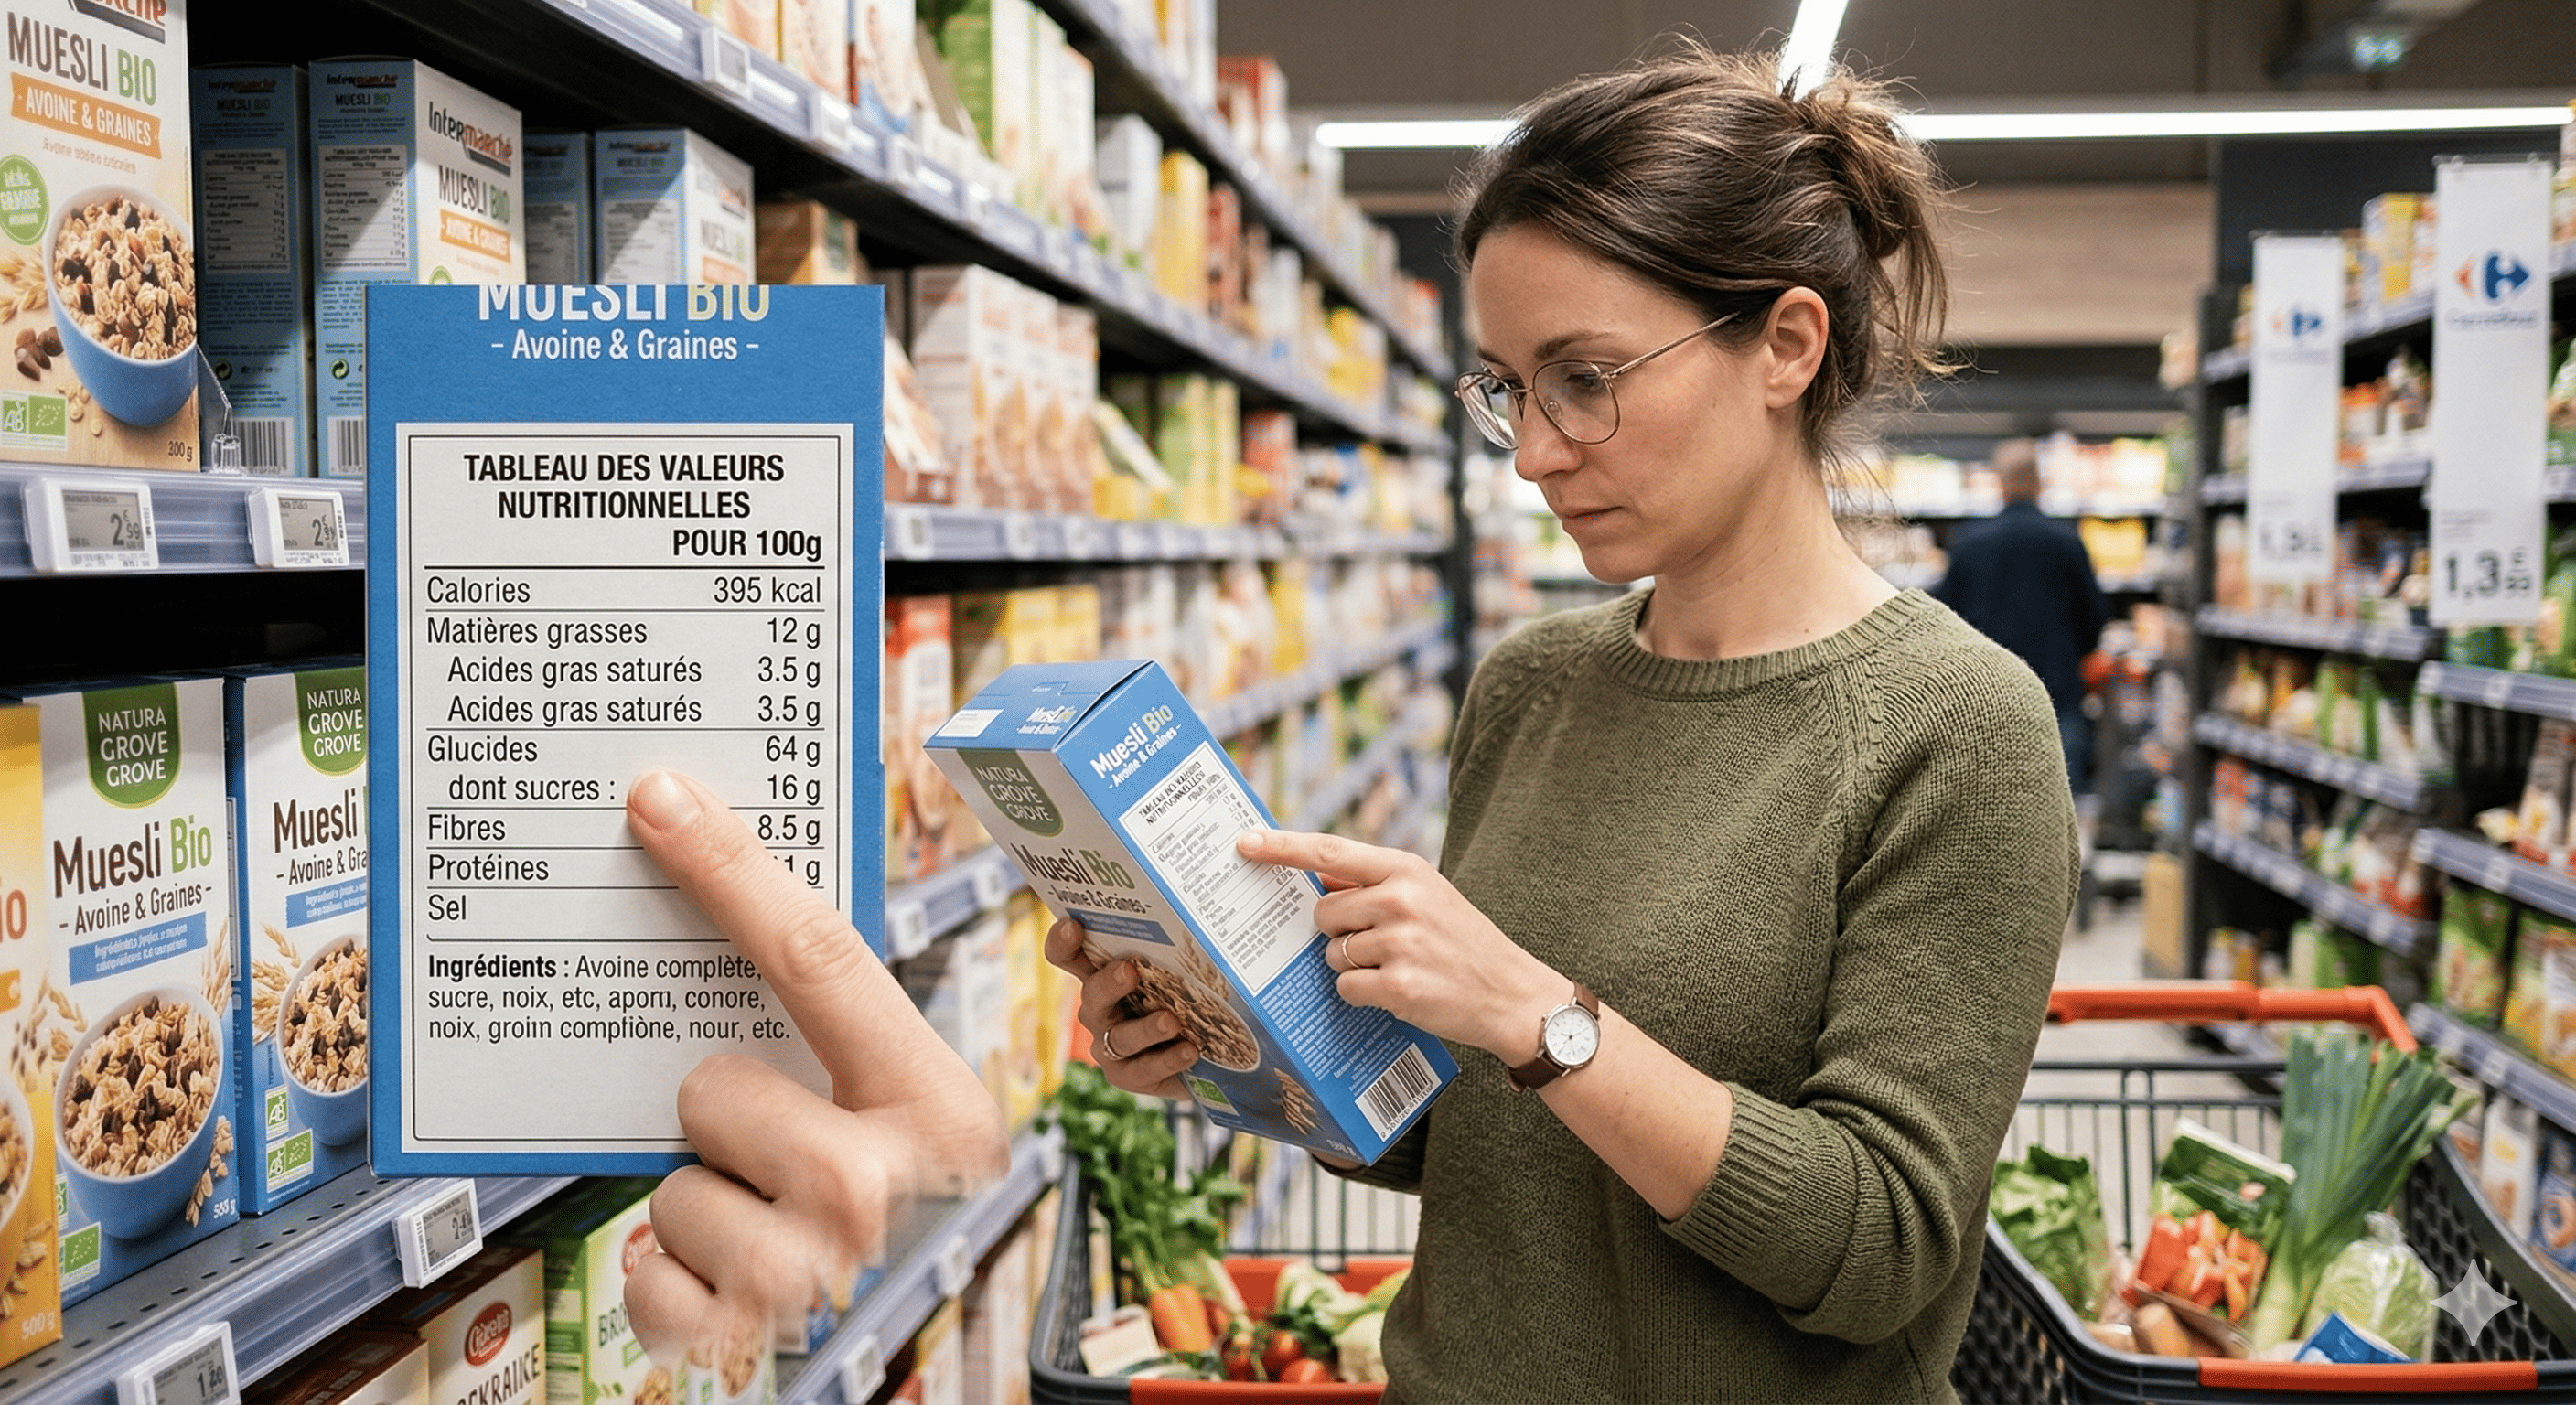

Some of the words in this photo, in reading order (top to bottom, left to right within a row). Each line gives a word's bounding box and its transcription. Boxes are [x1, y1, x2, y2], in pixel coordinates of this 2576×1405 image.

[7, 11, 109, 92] MUESLI
[117, 48, 157, 107] BIO
[26, 85, 80, 127] AVOINE
[81, 101, 93, 130] &
[96, 106, 152, 147] GRAINES
[437, 164, 488, 217] MUESLI
[478, 284, 667, 321] MUESLI
[511, 327, 602, 359] Avoine
[609, 327, 629, 359] &
[637, 327, 738, 359] Graines
[186, 445, 193, 463] g
[462, 453, 588, 483] TABLEAU
[596, 453, 652, 483] DES
[659, 453, 785, 483] VALEURS
[498, 489, 752, 520] NUTRITIONNELLES
[672, 528, 747, 557] POUR
[757, 529, 822, 563] 100g
[426, 574, 531, 605] Calories
[713, 575, 763, 605] 395
[771, 575, 821, 605] kcal
[426, 616, 539, 645] Matières
[546, 622, 649, 650] grasses
[767, 616, 799, 644] 12
[805, 622, 821, 650] g
[446, 654, 534, 684] Acides
[542, 660, 599, 690] gras
[606, 654, 703, 684] saturés
[757, 654, 799, 684] 3.5
[805, 660, 821, 690] g
[306, 687, 363, 711] NATURA
[446, 694, 534, 724] Acides
[542, 700, 599, 729] gras
[606, 693, 703, 724] saturés
[757, 693, 799, 723] 3.5
[805, 700, 821, 728] g
[97, 706, 167, 734] NATURA
[308, 708, 364, 735] GROVE
[100, 730, 170, 762] GROVE
[313, 733, 362, 758] GROVE
[426, 734, 539, 763] Glucides
[765, 734, 799, 763] 64
[805, 740, 821, 768] g
[1089, 721, 1150, 780] Muesli
[1141, 704, 1174, 735] Bio
[105, 758, 167, 788] GROVE
[447, 773, 508, 801] dont
[514, 778, 601, 802] sucres
[767, 773, 799, 801] 16
[805, 778, 821, 807] g
[274, 788, 358, 853] Muesli
[427, 812, 507, 842] Fibres
[757, 813, 798, 842] 8.5
[805, 819, 821, 847] g
[53, 820, 162, 900] Muesli
[170, 813, 213, 874] Bio
[288, 853, 333, 885] Avoine
[336, 848, 347, 874] &
[428, 853, 550, 882] Protéines
[805, 859, 821, 886] g
[1009, 842, 1097, 886] Muesli
[1079, 848, 1136, 891] Bio
[74, 897, 131, 936] Avoine
[134, 891, 146, 920] &
[150, 881, 202, 917] Graines
[427, 893, 467, 922] Sel
[428, 952, 558, 982] Ingrédients
[574, 954, 649, 980] Avoine
[655, 954, 763, 985] complète,
[427, 990, 495, 1013] sucre,
[501, 985, 554, 1013] noix,
[561, 986, 602, 1013] etc,
[684, 990, 767, 1013] conore,
[428, 1015, 481, 1044] noix,
[688, 1020, 746, 1044] nour,
[751, 1016, 793, 1041] etc.
